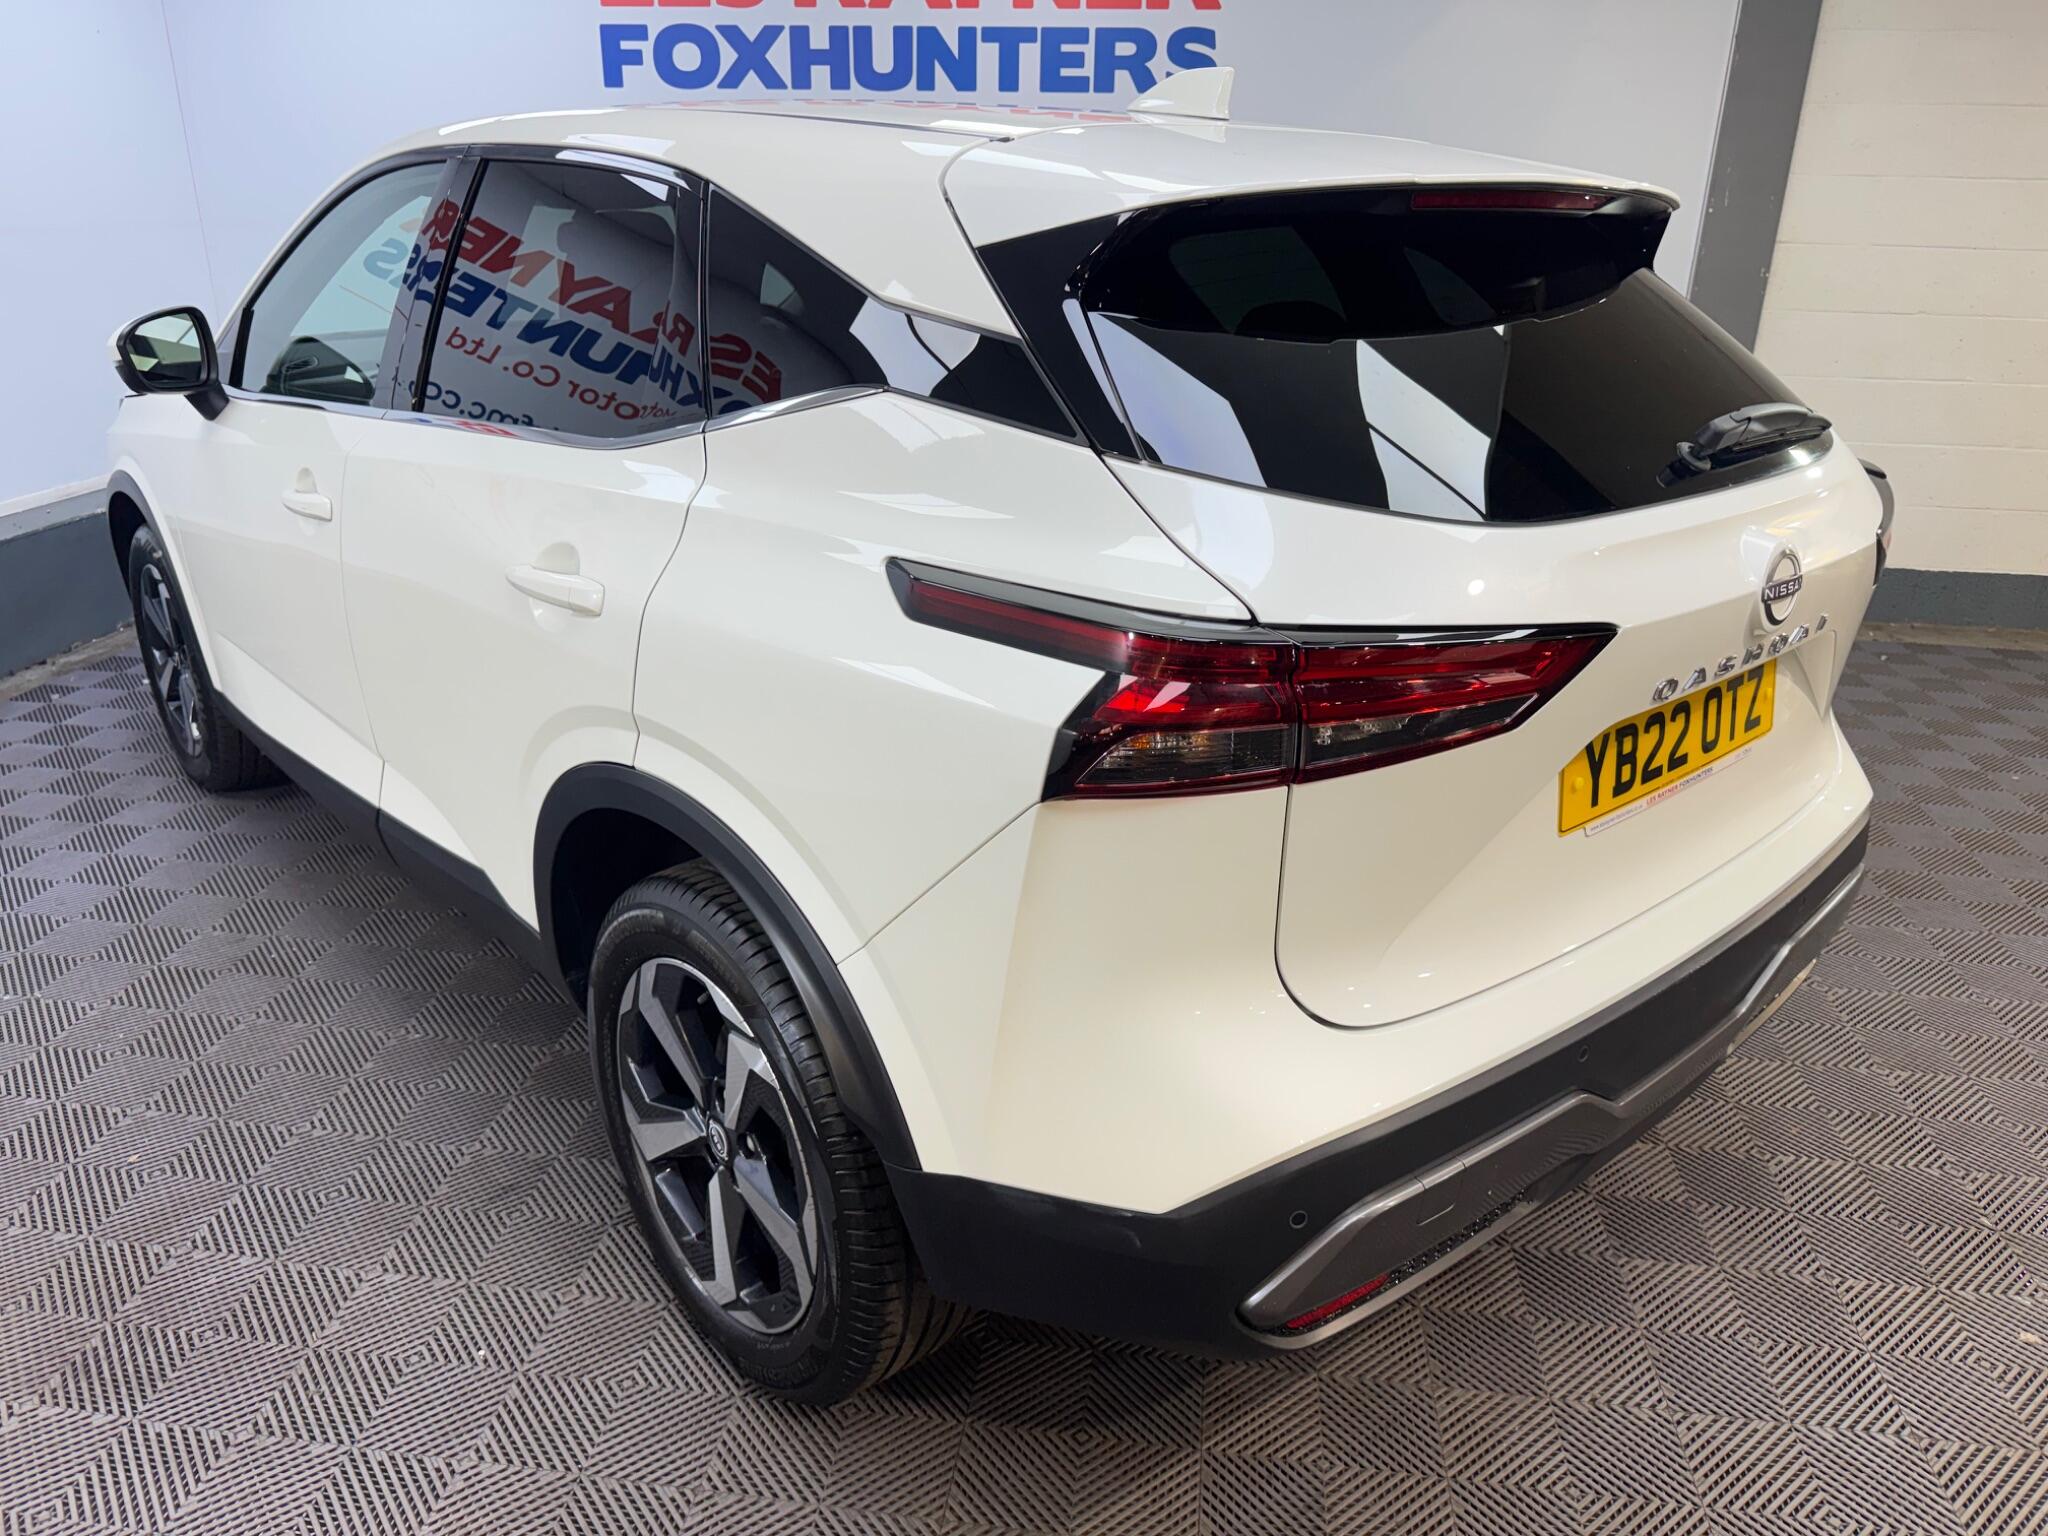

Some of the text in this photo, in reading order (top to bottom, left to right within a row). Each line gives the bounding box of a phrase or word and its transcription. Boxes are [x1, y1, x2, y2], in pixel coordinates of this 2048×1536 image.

[599, 23, 1217, 93] FOXHUNTERS
[1764, 577, 1801, 600] NISSA
[1651, 613, 1829, 702] QASHQAI
[1585, 664, 1766, 809] YB22 OTZ
